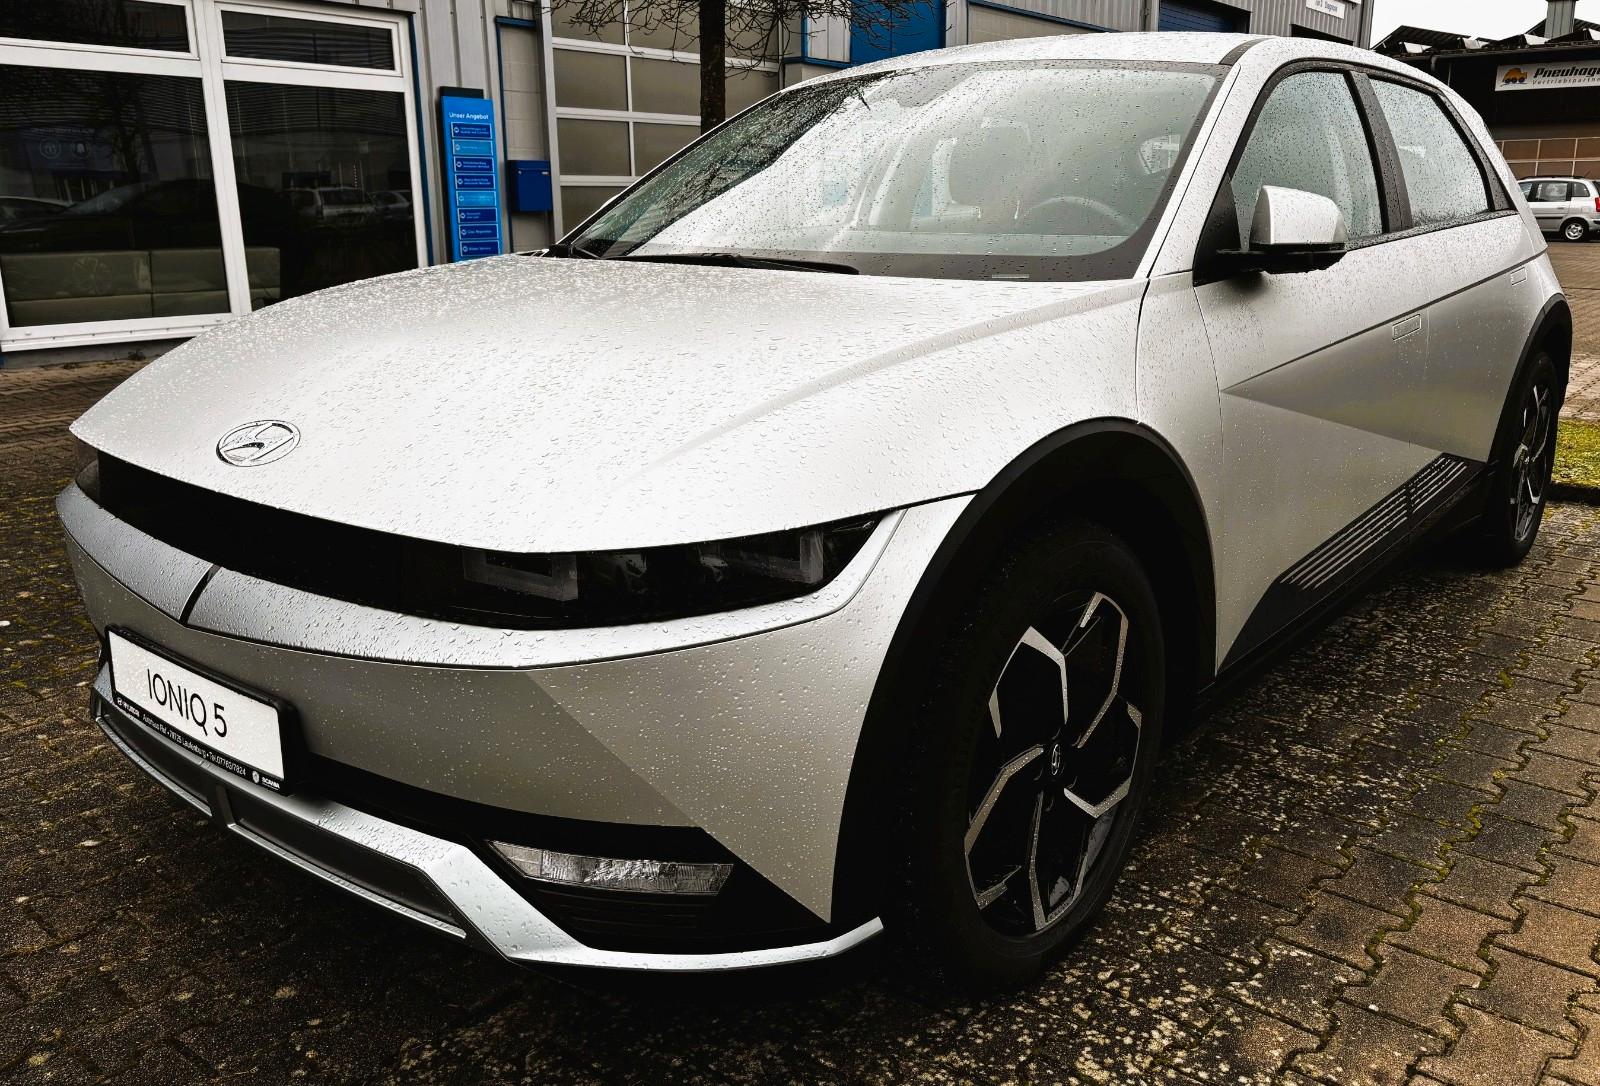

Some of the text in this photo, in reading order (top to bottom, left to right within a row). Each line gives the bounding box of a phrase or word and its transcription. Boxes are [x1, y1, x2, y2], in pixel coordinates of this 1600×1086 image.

[449, 111, 489, 121] Unser Angebot
[147, 668, 227, 737] IONIQ 5
